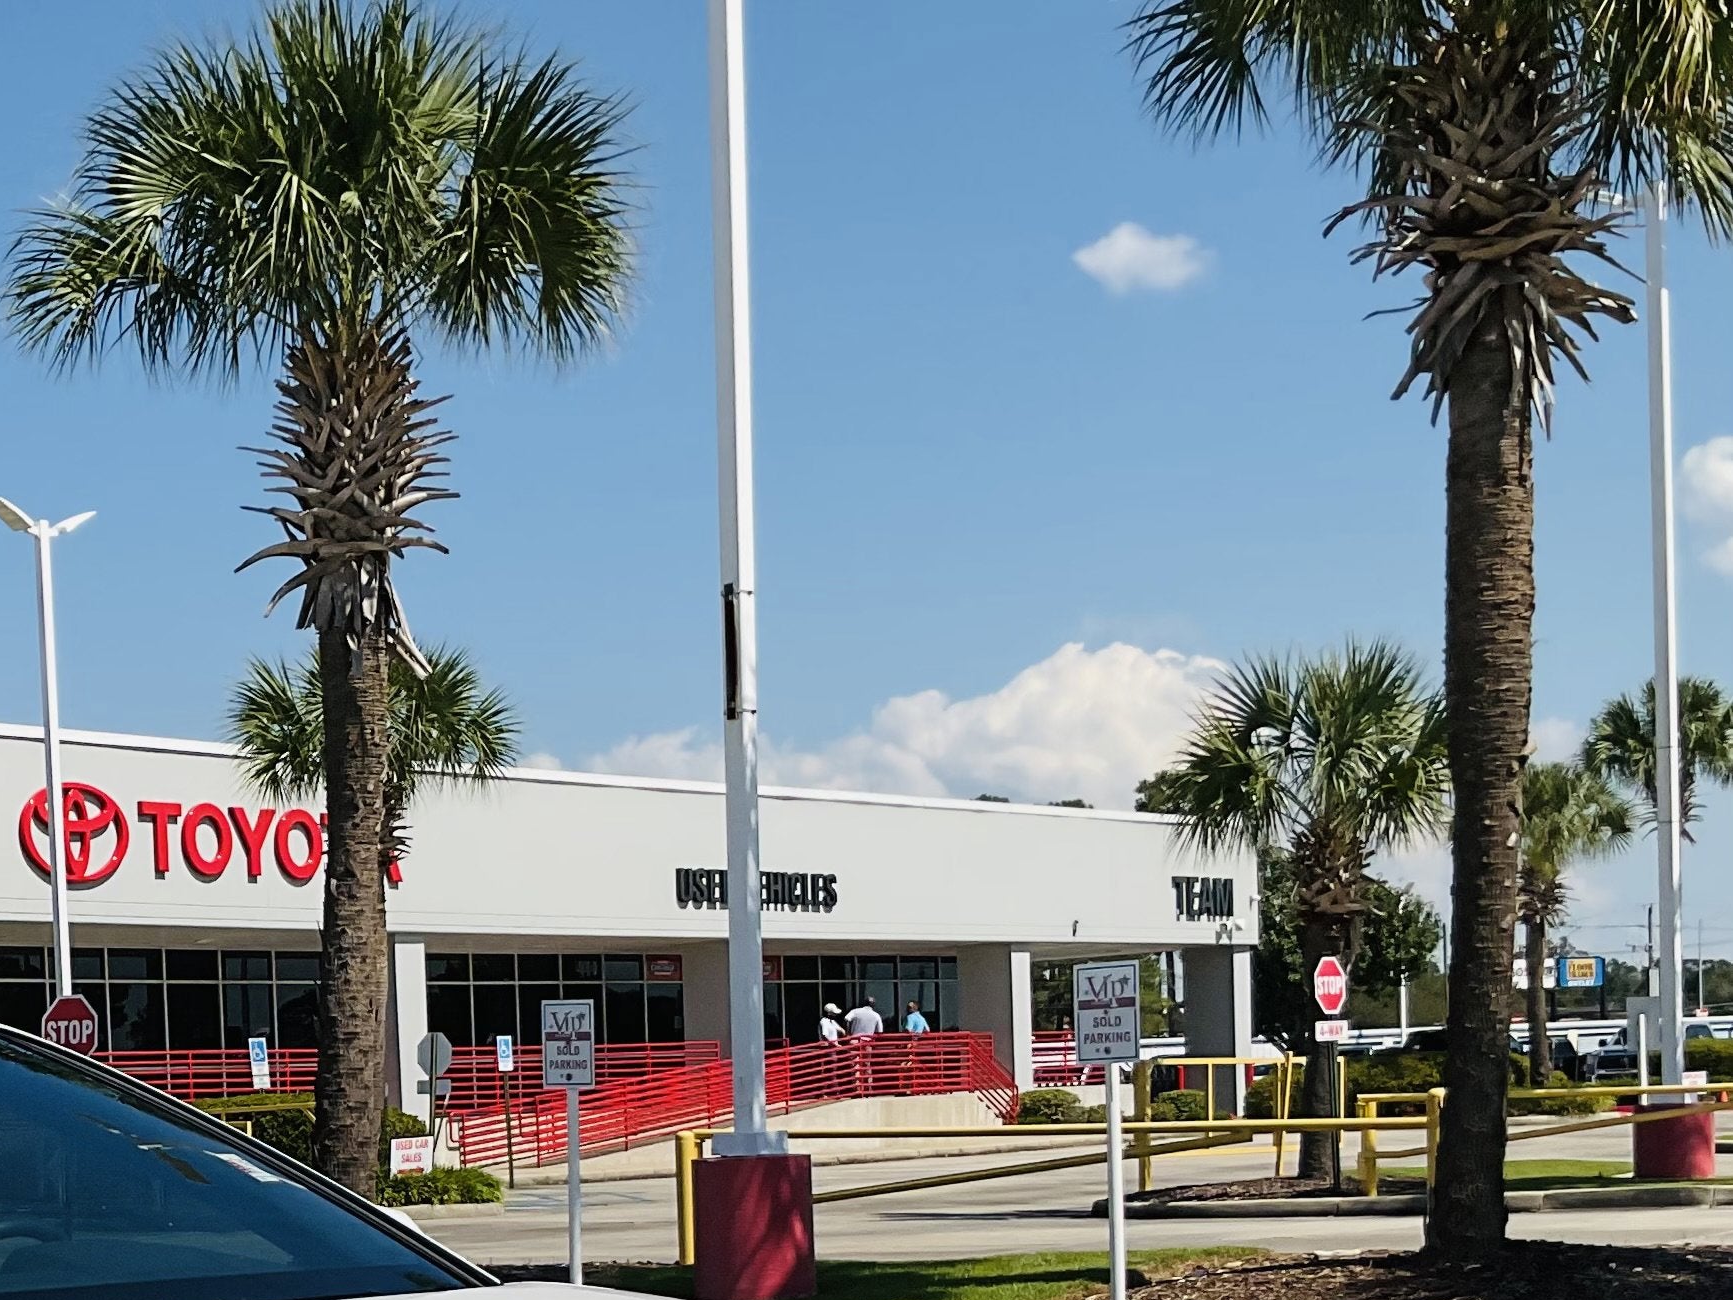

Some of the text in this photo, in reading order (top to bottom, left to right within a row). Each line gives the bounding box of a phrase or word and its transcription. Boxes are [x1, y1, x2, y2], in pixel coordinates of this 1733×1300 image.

[137, 800, 404, 884] TOYO
[759, 870, 838, 908] EHICLES
[1171, 876, 1234, 918] TEAM
[1317, 975, 1343, 995] STOP
[1092, 1015, 1122, 1029] SOLD
[47, 1020, 94, 1045] STOP
[1083, 1031, 1131, 1045] PARKING
[556, 1045, 580, 1056] SOLD
[549, 1060, 588, 1070] PARKING
